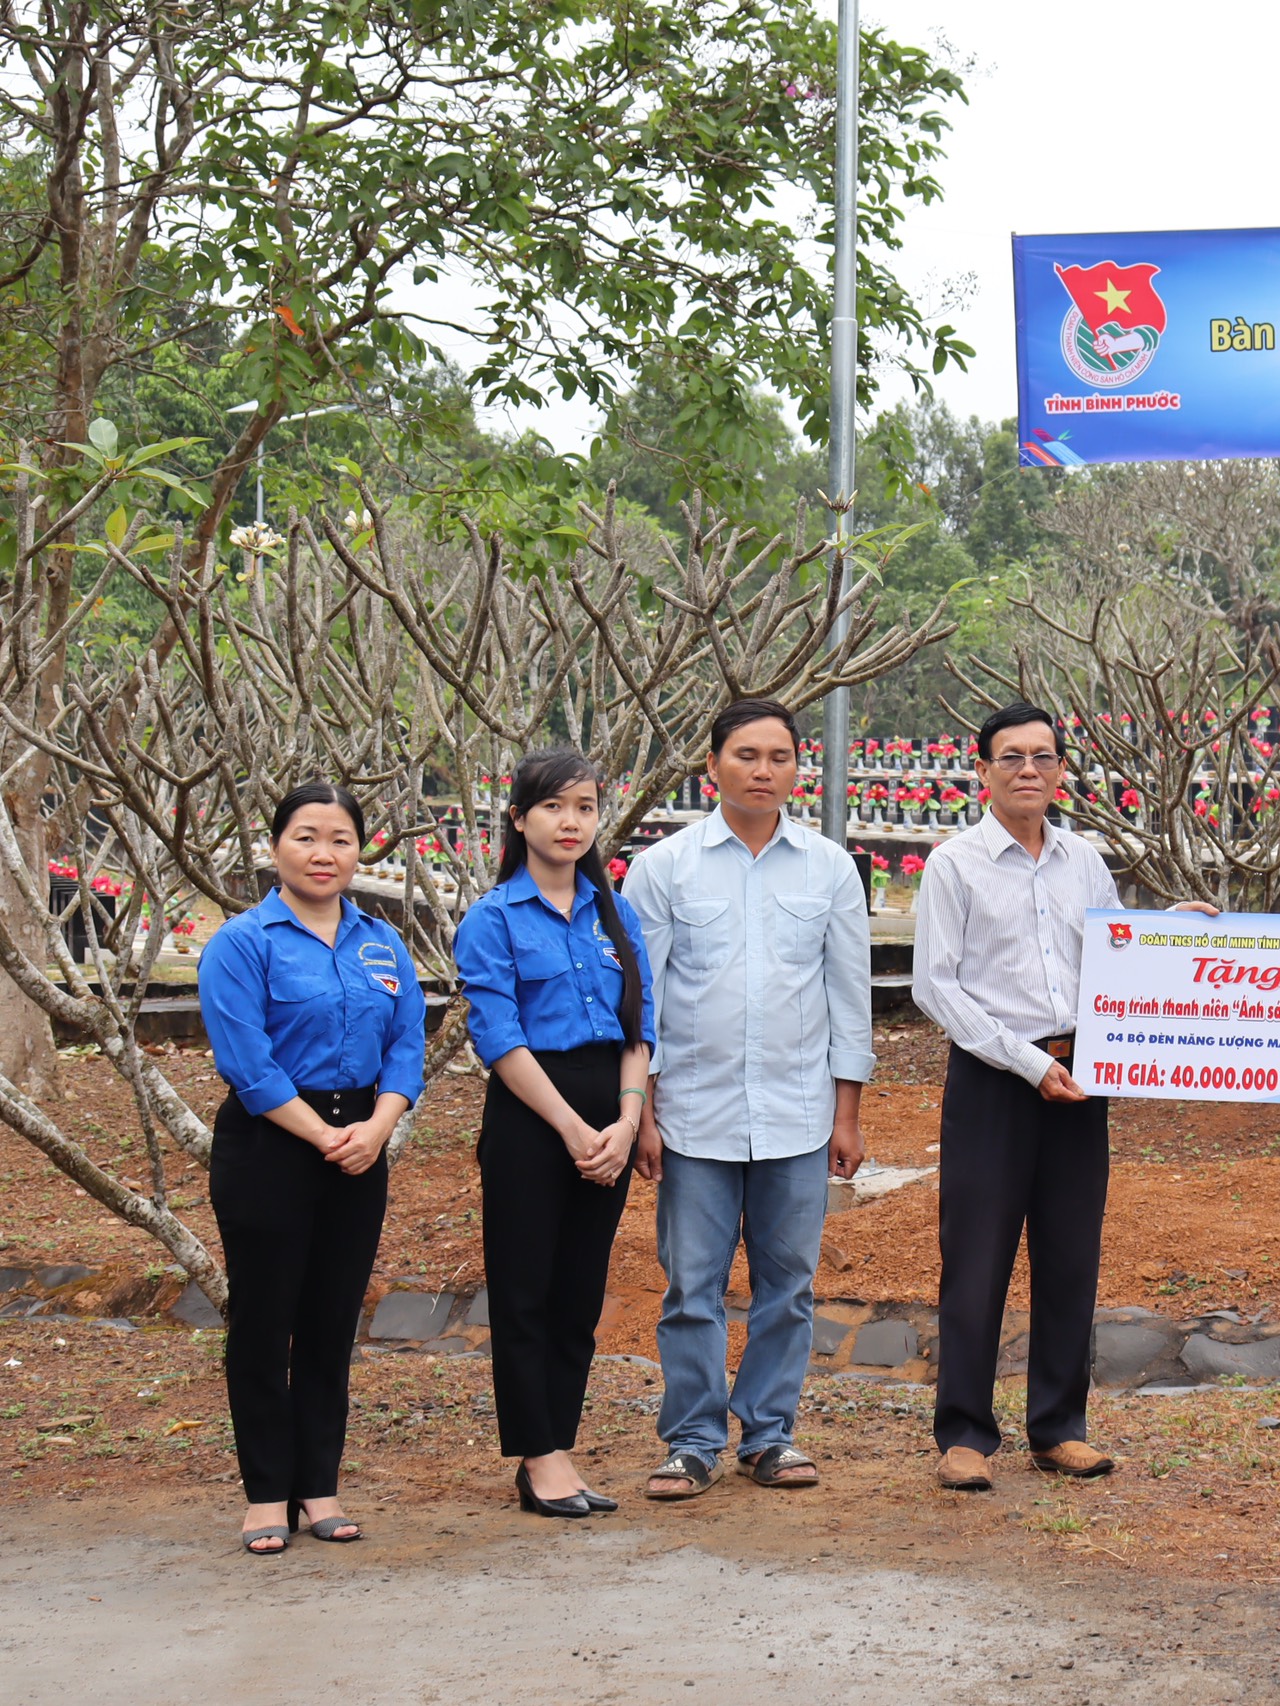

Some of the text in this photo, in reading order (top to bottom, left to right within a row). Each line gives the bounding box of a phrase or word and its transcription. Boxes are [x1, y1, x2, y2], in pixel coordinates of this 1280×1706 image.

[1210, 316, 1275, 352] Bàn
[1046, 391, 1179, 412] TỈNH BÌNH PHƯỚC
[1139, 932, 1168, 946] ĐOÀN
[1170, 934, 1193, 947] TNCS
[1211, 933, 1228, 948] CHÍ
[1230, 936, 1255, 949] MINH
[1093, 994, 1125, 1019] Công
[1129, 996, 1159, 1016] trình
[1163, 997, 1199, 1018] thanh
[1202, 997, 1229, 1018] niên
[1106, 1032, 1123, 1043] 04
[1127, 1031, 1144, 1046] BỘ
[1149, 1031, 1174, 1045] ĐÈN
[1178, 1033, 1215, 1046] NĂNG
[1219, 1036, 1264, 1050] LƯỢNG
[1093, 1061, 1122, 1091] TRỊ
[1127, 1058, 1165, 1087] GIÁ:
[1170, 1064, 1278, 1091] 40.000.000
